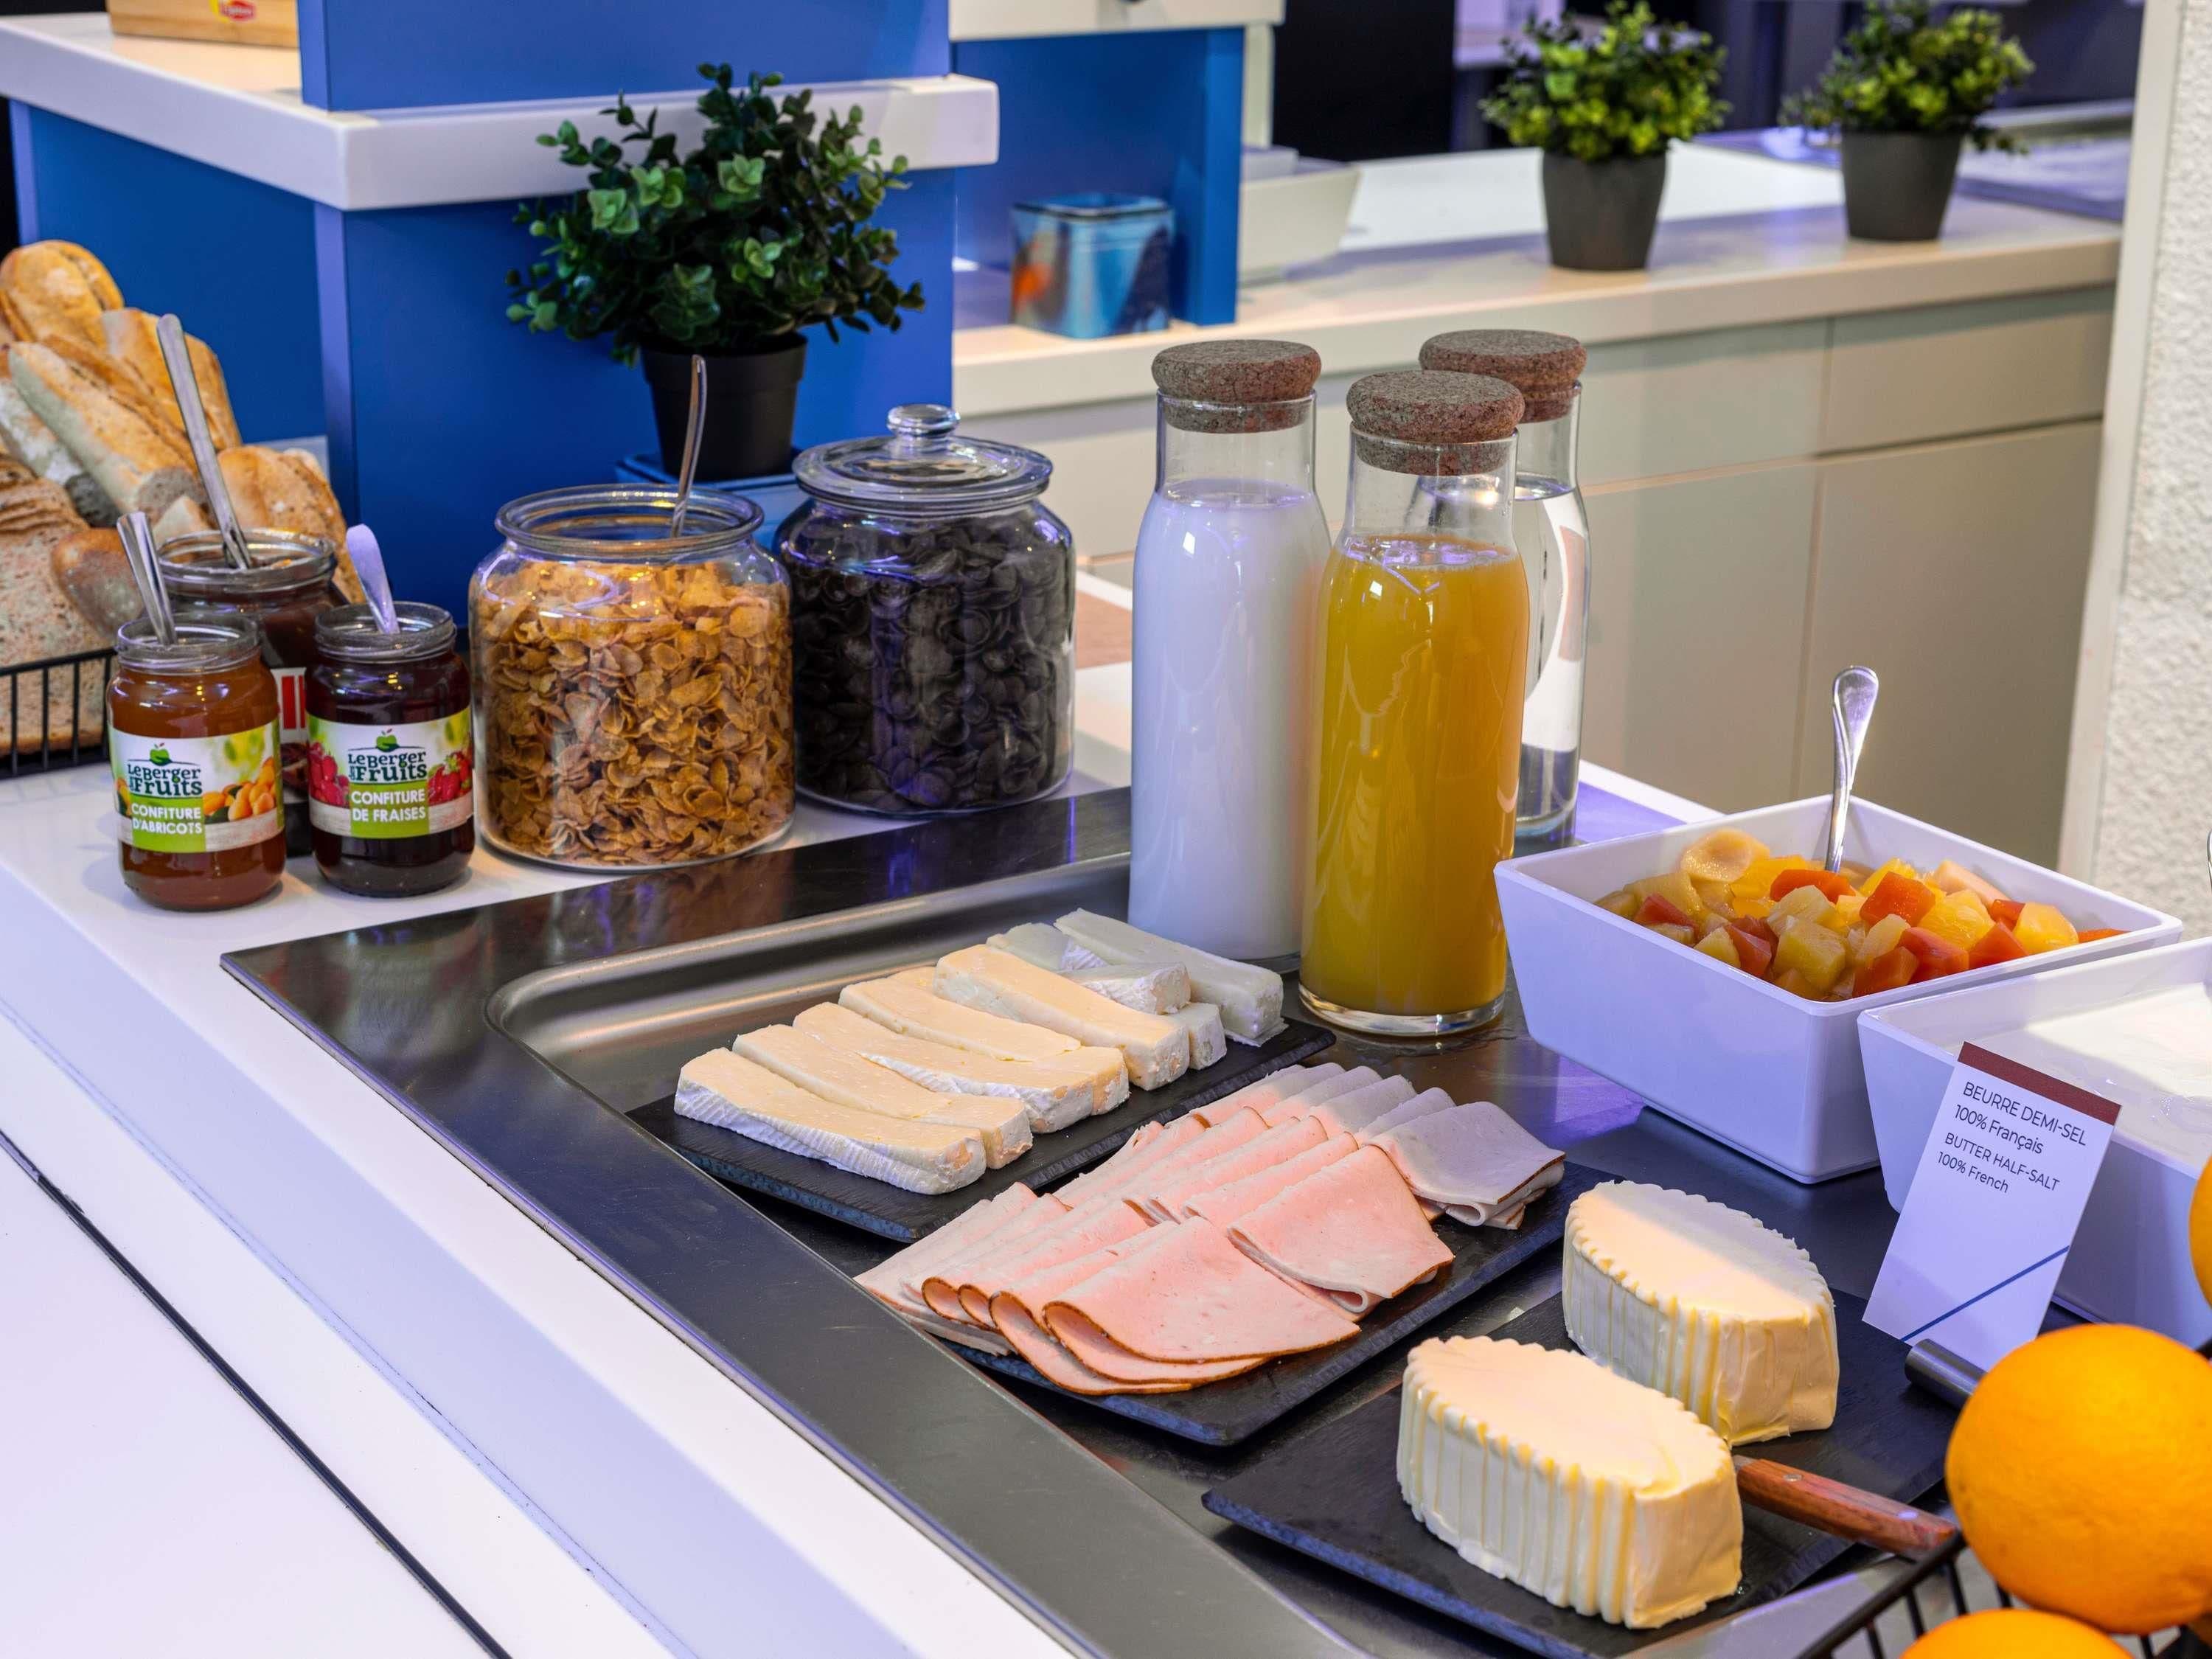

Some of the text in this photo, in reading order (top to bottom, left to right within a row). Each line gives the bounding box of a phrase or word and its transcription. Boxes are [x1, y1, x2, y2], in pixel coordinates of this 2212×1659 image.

[366, 751, 426, 768] Berger
[142, 767, 201, 783] Berger
[356, 762, 428, 782] Fruits
[133, 777, 203, 796] Fruits
[351, 788, 425, 805] CONFITURE
[131, 802, 201, 820] CONFITURE
[352, 806, 425, 823] DE FRAISES
[132, 816, 202, 835] D'ABRICOTS
[1962, 1081, 2087, 1147] BEURRE DEMI-SEL
[1955, 1104, 2045, 1155] 100% Français
[1944, 1132, 2060, 1192] BUTTER HALF-SALT
[1937, 1151, 2010, 1193] 100% French
